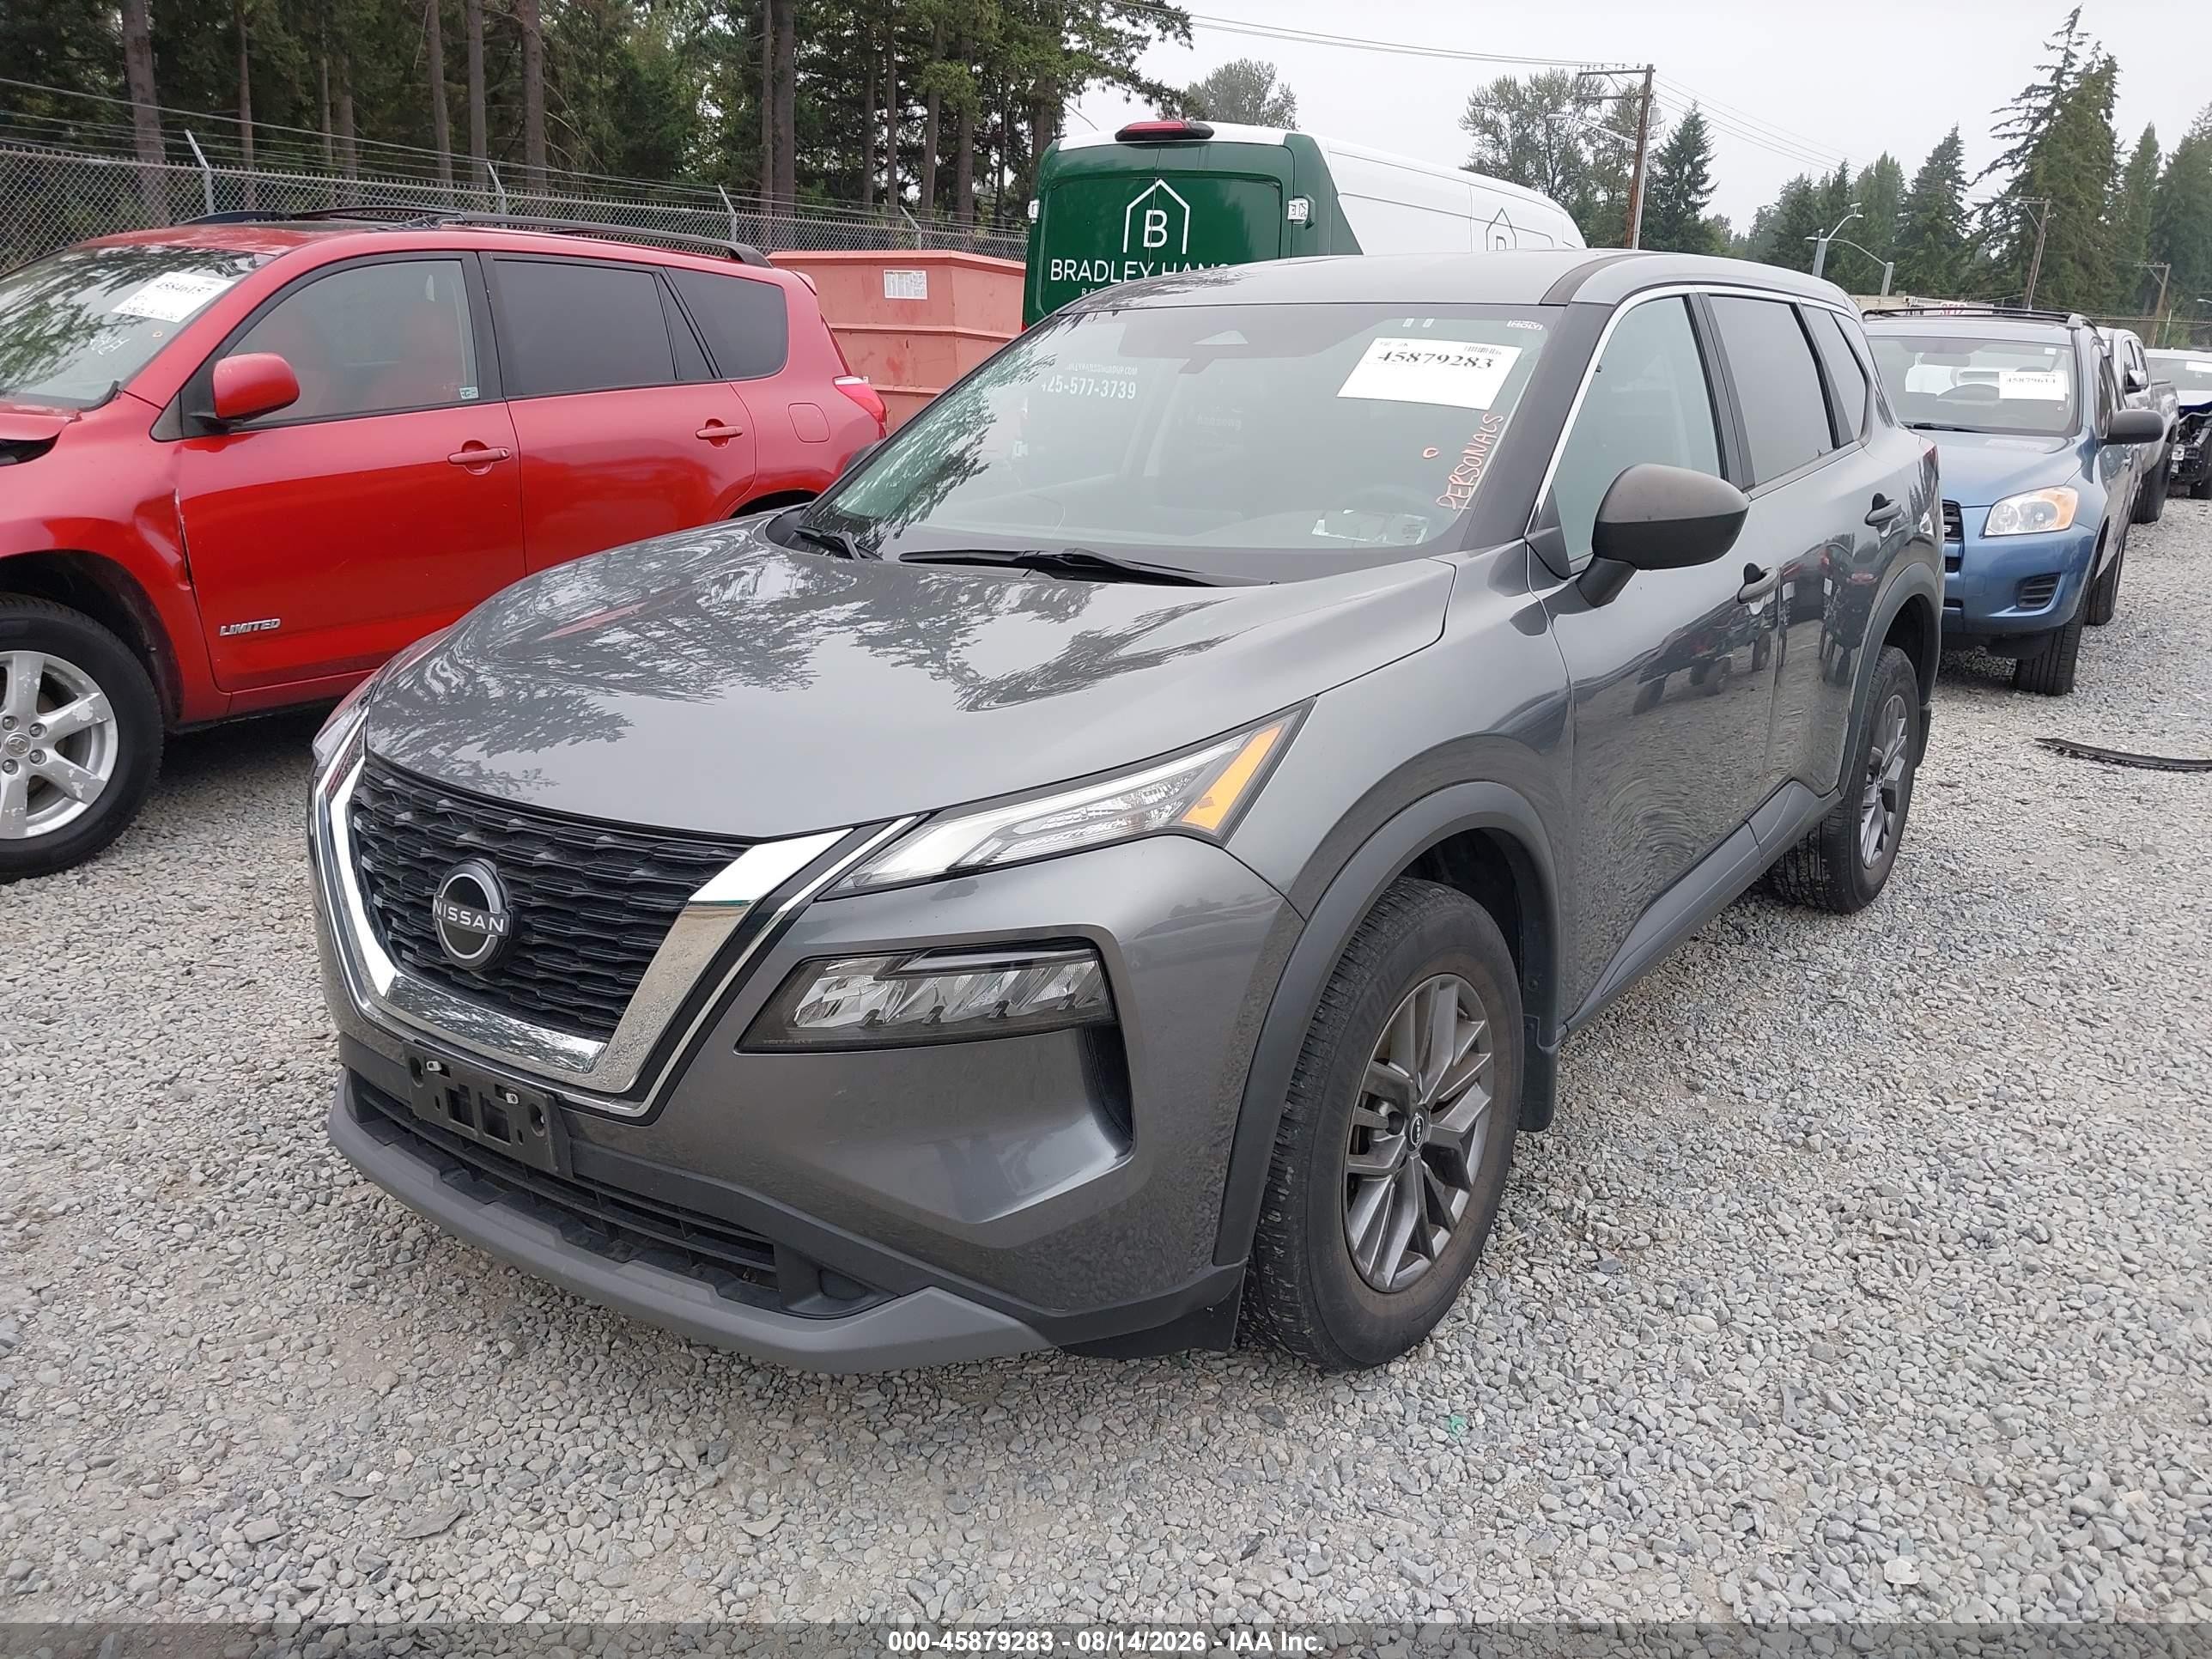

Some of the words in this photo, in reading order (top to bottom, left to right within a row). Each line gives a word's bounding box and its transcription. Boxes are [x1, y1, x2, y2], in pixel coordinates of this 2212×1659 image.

[1143, 210, 1168, 247] B
[1050, 258, 1154, 283] BRADLEY
[1377, 350, 1494, 369] 45879283
[1436, 413, 1504, 510] PERSONALS
[219, 618, 281, 636] LIMITED
[434, 899, 504, 933] NISSAN
